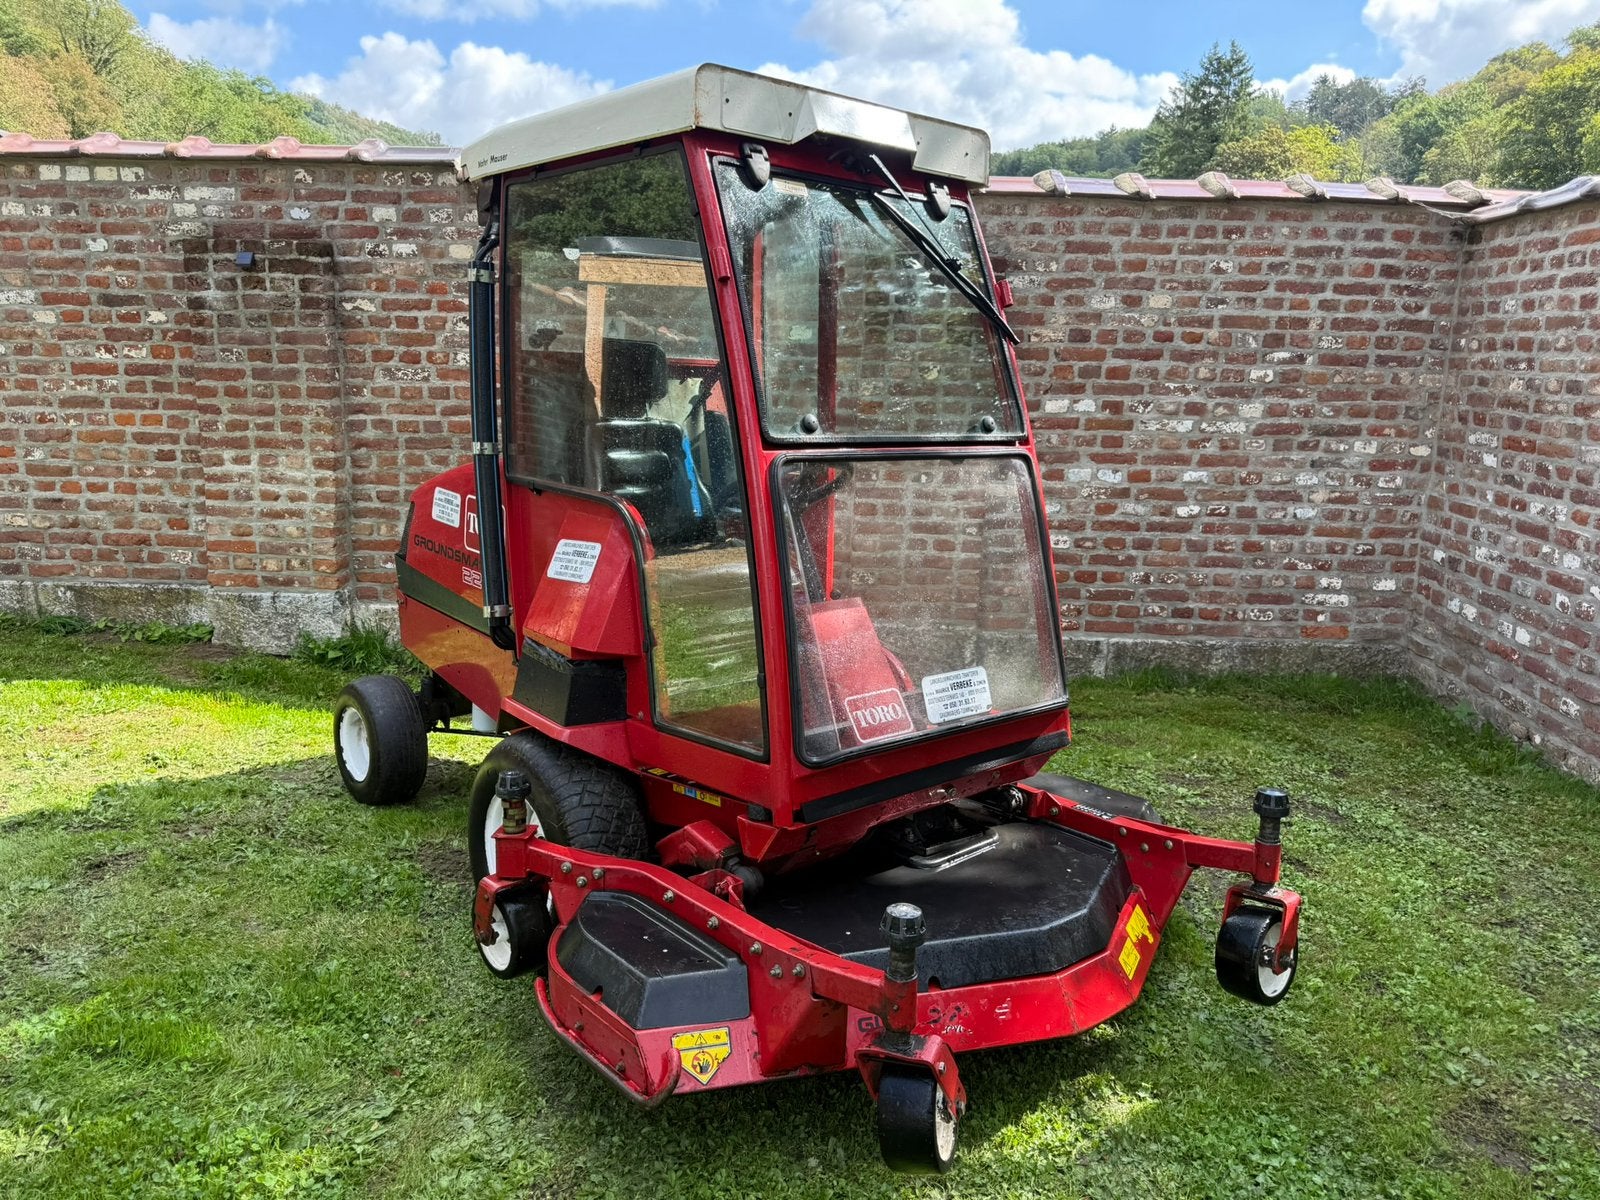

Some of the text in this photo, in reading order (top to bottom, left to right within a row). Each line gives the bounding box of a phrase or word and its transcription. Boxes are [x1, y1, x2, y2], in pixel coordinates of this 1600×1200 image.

[490, 153, 508, 164] Mauser
[414, 534, 480, 568] GROUNDSMA
[462, 566, 483, 589] 22
[949, 679, 973, 691] VERBEKE
[853, 703, 902, 728] TORO
